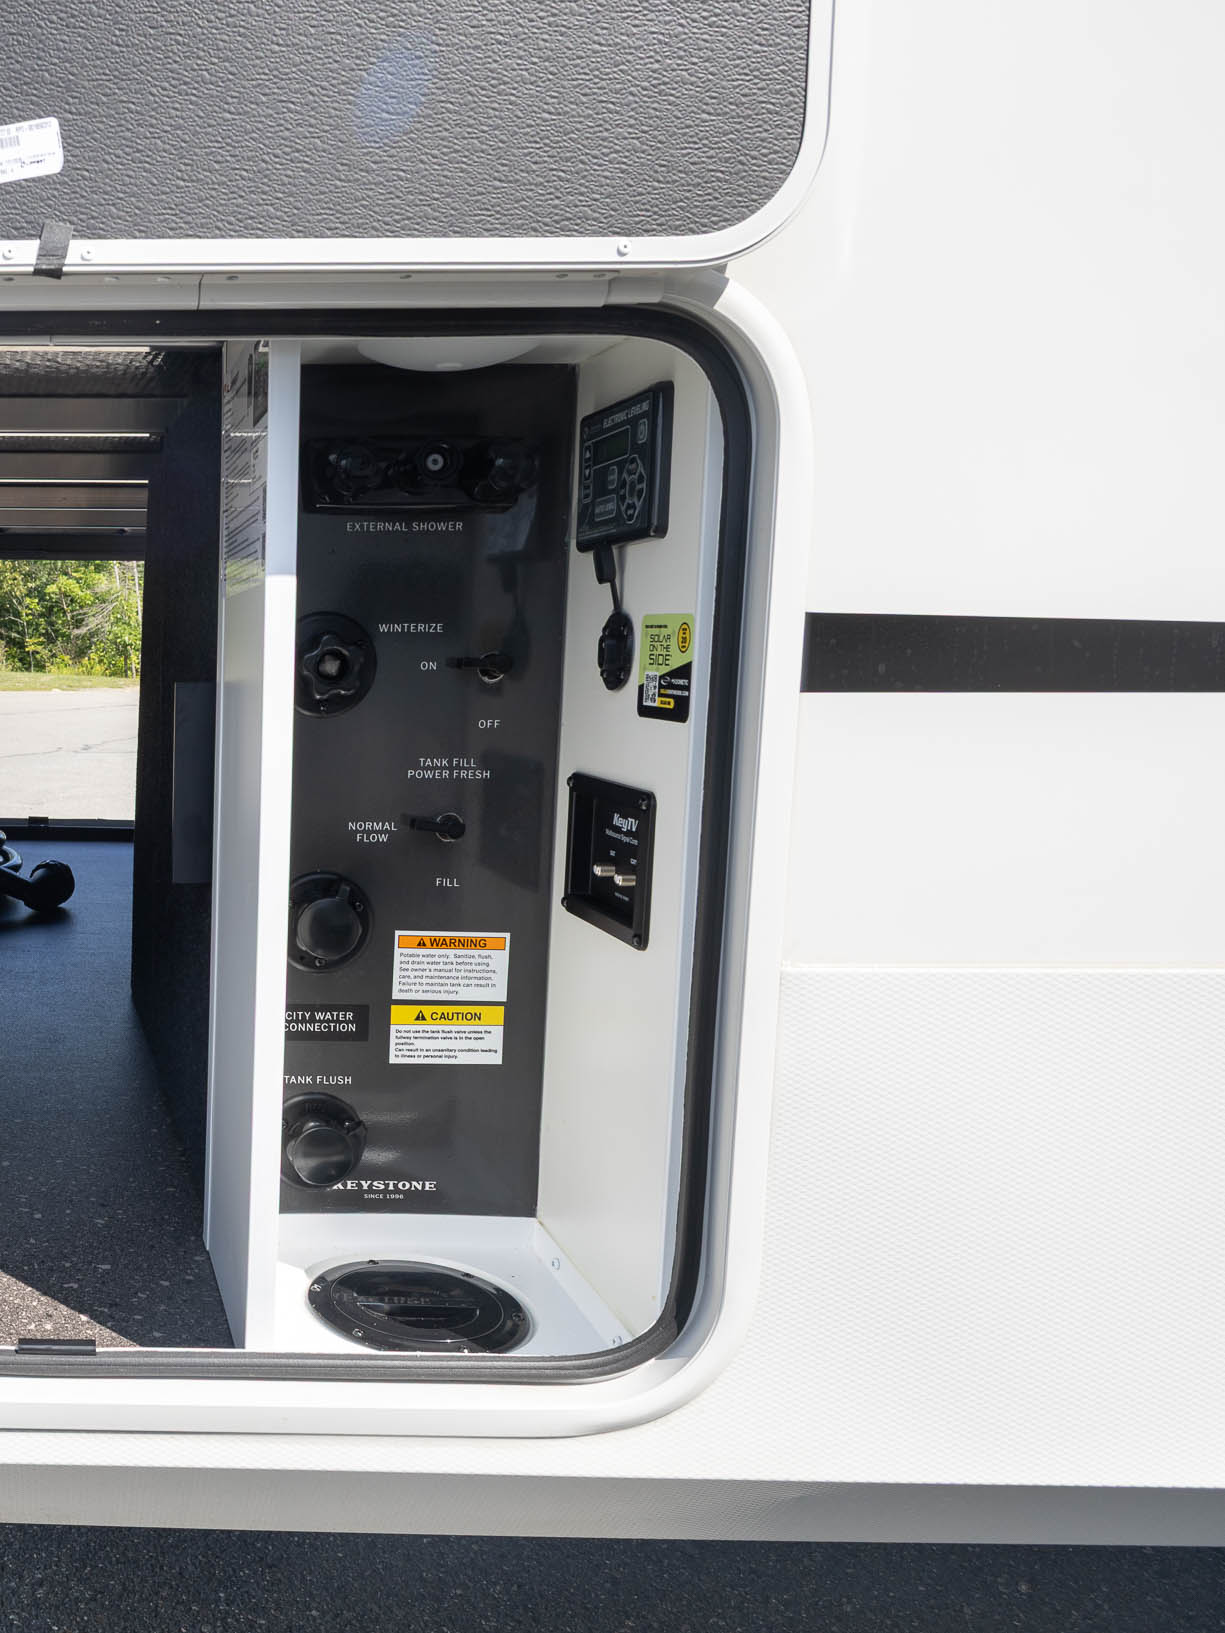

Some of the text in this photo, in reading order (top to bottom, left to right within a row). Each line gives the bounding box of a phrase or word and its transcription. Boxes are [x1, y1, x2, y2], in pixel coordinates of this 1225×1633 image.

[347, 522, 463, 532] EXTERNAL SHOWER
[379, 623, 444, 633] WINTERIZE
[650, 634, 671, 642] SOLAR
[420, 661, 437, 671] ON
[478, 720, 501, 729] OFF
[419, 758, 477, 767] TANK FILL
[407, 770, 490, 779] POWER FRESH
[348, 822, 397, 831] NORMAL
[613, 813, 638, 832] KeyTV
[357, 834, 388, 842] FLOW
[436, 878, 460, 887] FILL
[430, 938, 487, 948] WARNING
[286, 1012, 353, 1020] CITY WATER
[430, 1012, 482, 1021] CAUTION
[284, 1023, 356, 1032] CONNECTION
[284, 1076, 352, 1084] TANK FLUSH
